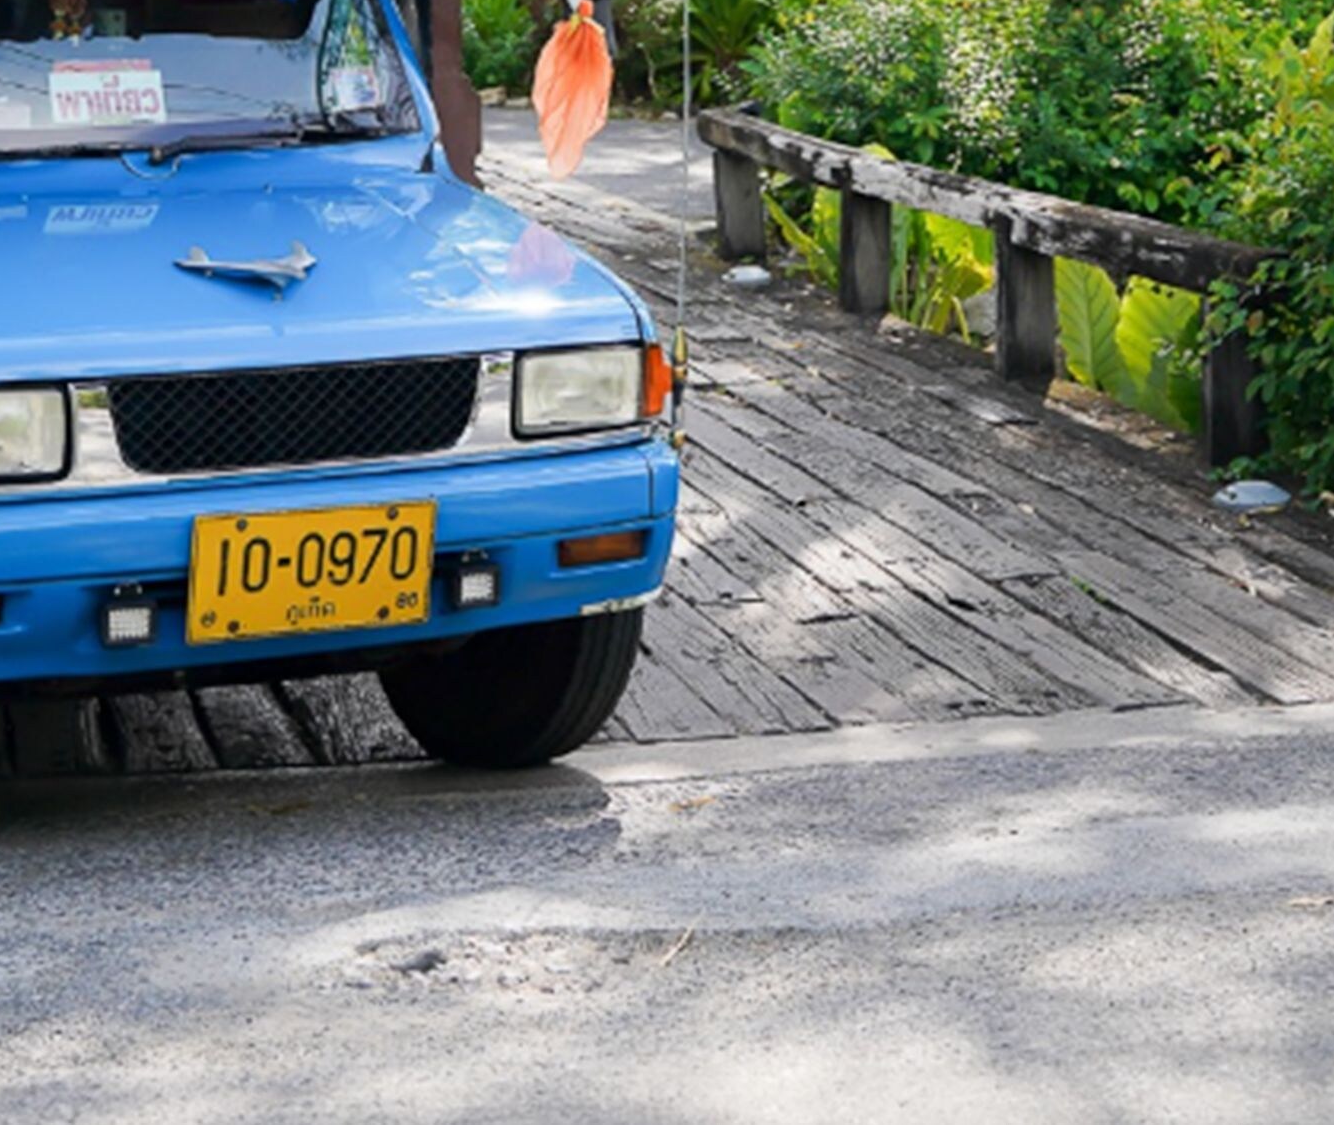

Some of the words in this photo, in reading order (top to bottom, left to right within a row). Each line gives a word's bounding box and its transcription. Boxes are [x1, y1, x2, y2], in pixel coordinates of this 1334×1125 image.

[217, 525, 418, 597] 10-0970
[285, 594, 336, 626] ภูเก็ต
